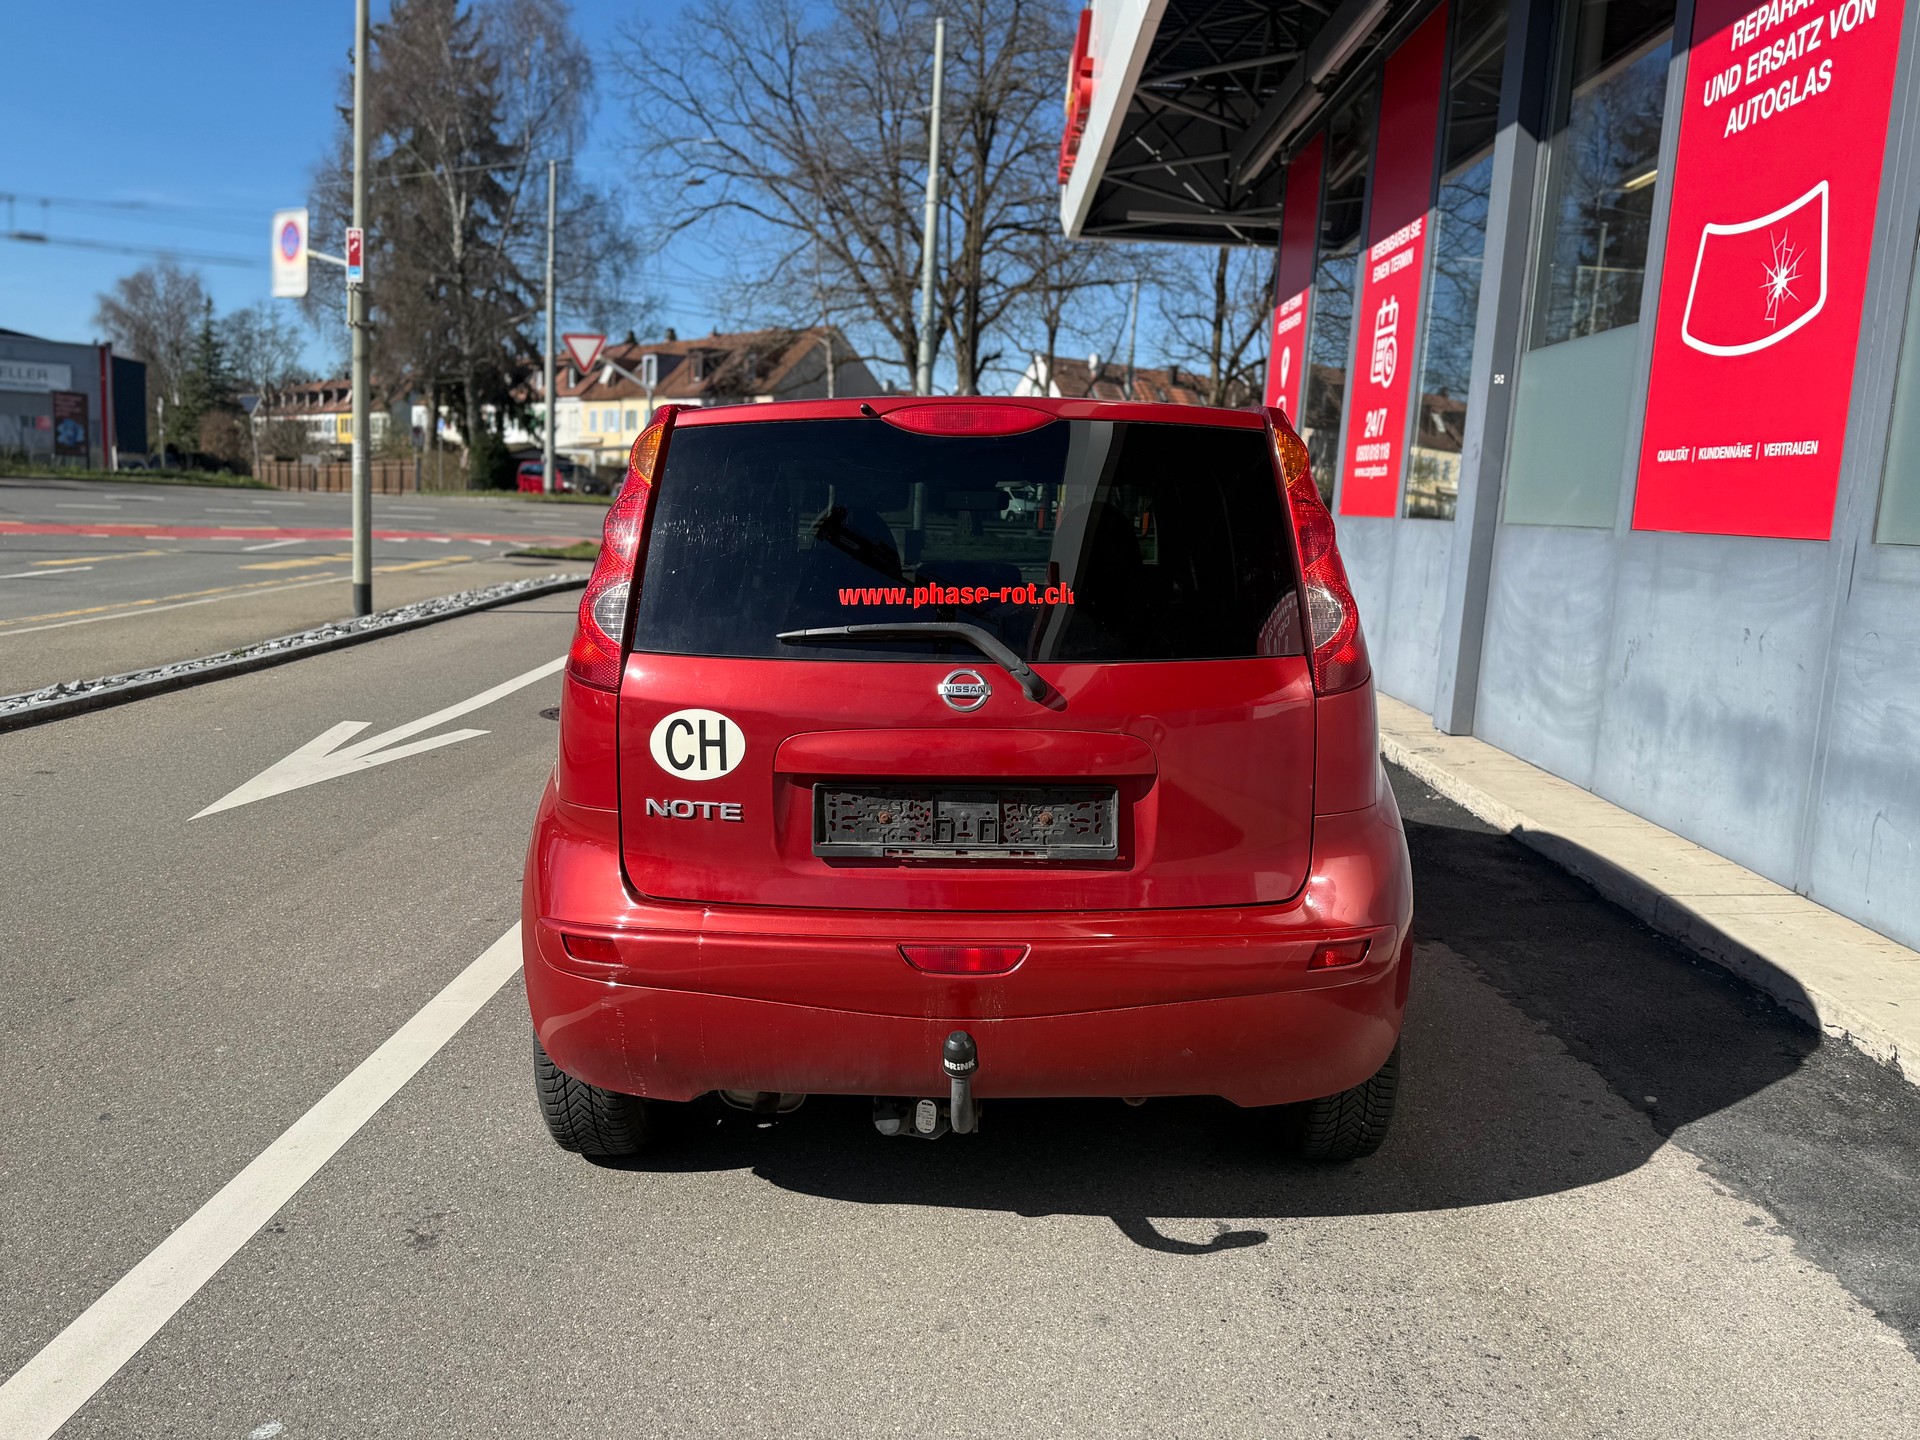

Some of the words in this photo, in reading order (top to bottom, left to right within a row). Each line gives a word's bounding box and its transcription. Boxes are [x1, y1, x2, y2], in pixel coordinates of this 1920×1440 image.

[1704, 63, 1742, 107] UND
[1745, 15, 1825, 86] ERSATZ
[1829, 0, 1877, 40] VON
[1723, 58, 1833, 138] AUTOGLAS
[1410, 217, 1422, 240] SIE
[1391, 246, 1414, 274] TERMIN
[1364, 407, 1388, 439] 24/7
[1657, 446, 1690, 463] QUALITÄT
[1698, 442, 1753, 460] KUNDENNÄHE
[1763, 440, 1819, 457] VERTRAUEN
[839, 581, 1075, 609] www.phase-rot.ch
[943, 684, 987, 694] NISSAN
[665, 718, 728, 771] CH
[645, 798, 742, 821] NOTE
